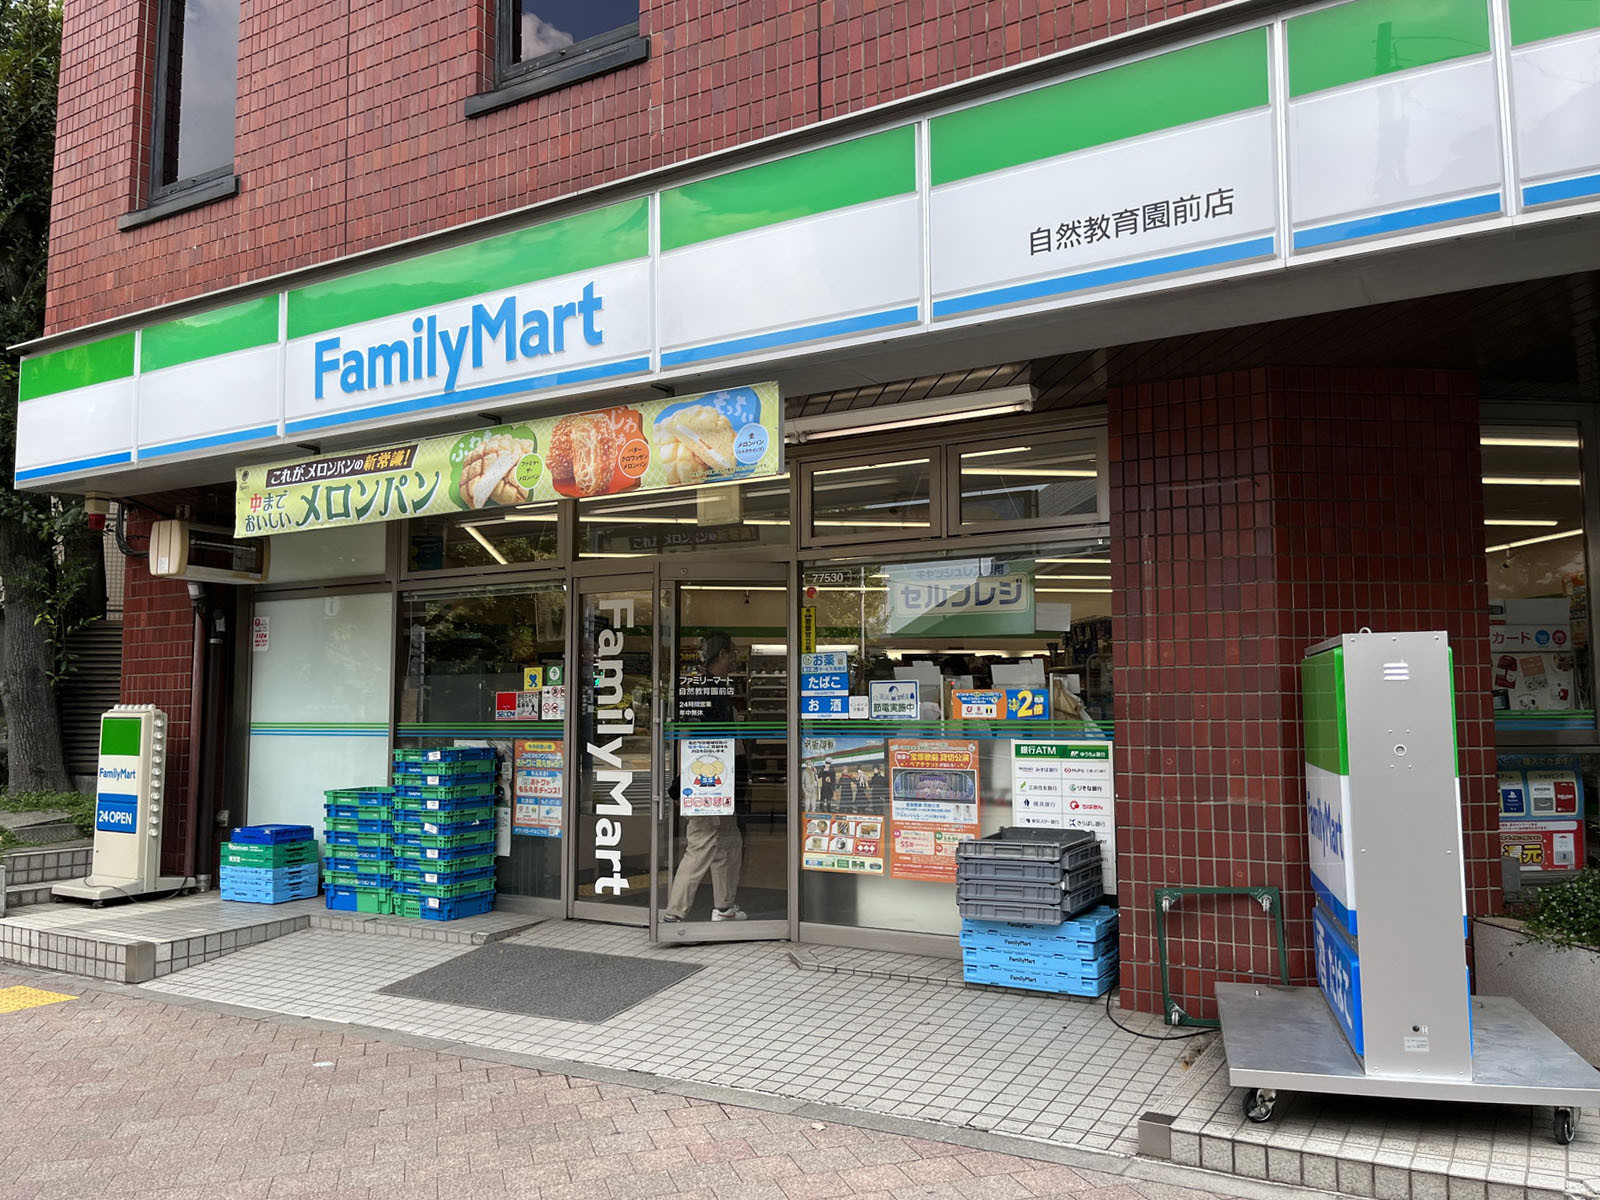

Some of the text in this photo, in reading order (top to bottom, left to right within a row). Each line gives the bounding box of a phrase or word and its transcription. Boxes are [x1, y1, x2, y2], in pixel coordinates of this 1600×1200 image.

[1029, 188, 1235, 257] 自然教育園前店
[314, 280, 604, 400] FamilyMart
[737, 440, 765, 448] メロンパン
[621, 453, 648, 463] クロワッサン
[623, 462, 647, 470] メロンパン
[250, 489, 288, 513] 中まで
[295, 470, 440, 527] メロンパン
[245, 512, 292, 533] おいしい
[811, 572, 844, 583] 77530
[900, 577, 1023, 609] セルフレジ
[1492, 631, 1531, 645] カード
[812, 654, 835, 666] お薬
[679, 676, 734, 685] ファミリーマート
[808, 676, 841, 689] たばこ
[678, 687, 734, 696] 自然教育園前店
[808, 699, 820, 712] お
[873, 702, 915, 713] 節電実施中
[587, 598, 635, 896] FamilyMart
[1020, 745, 1057, 755] 銀行ATM
[99, 768, 137, 781] FamilyMart
[518, 785, 561, 794] もらえるチャンス!
[1077, 820, 1106, 828] きらぼし銀行
[1004, 939, 1032, 947] FamilyMart
[1008, 956, 1036, 965] FamilyMart
[1009, 974, 1037, 983] FamilyMart
